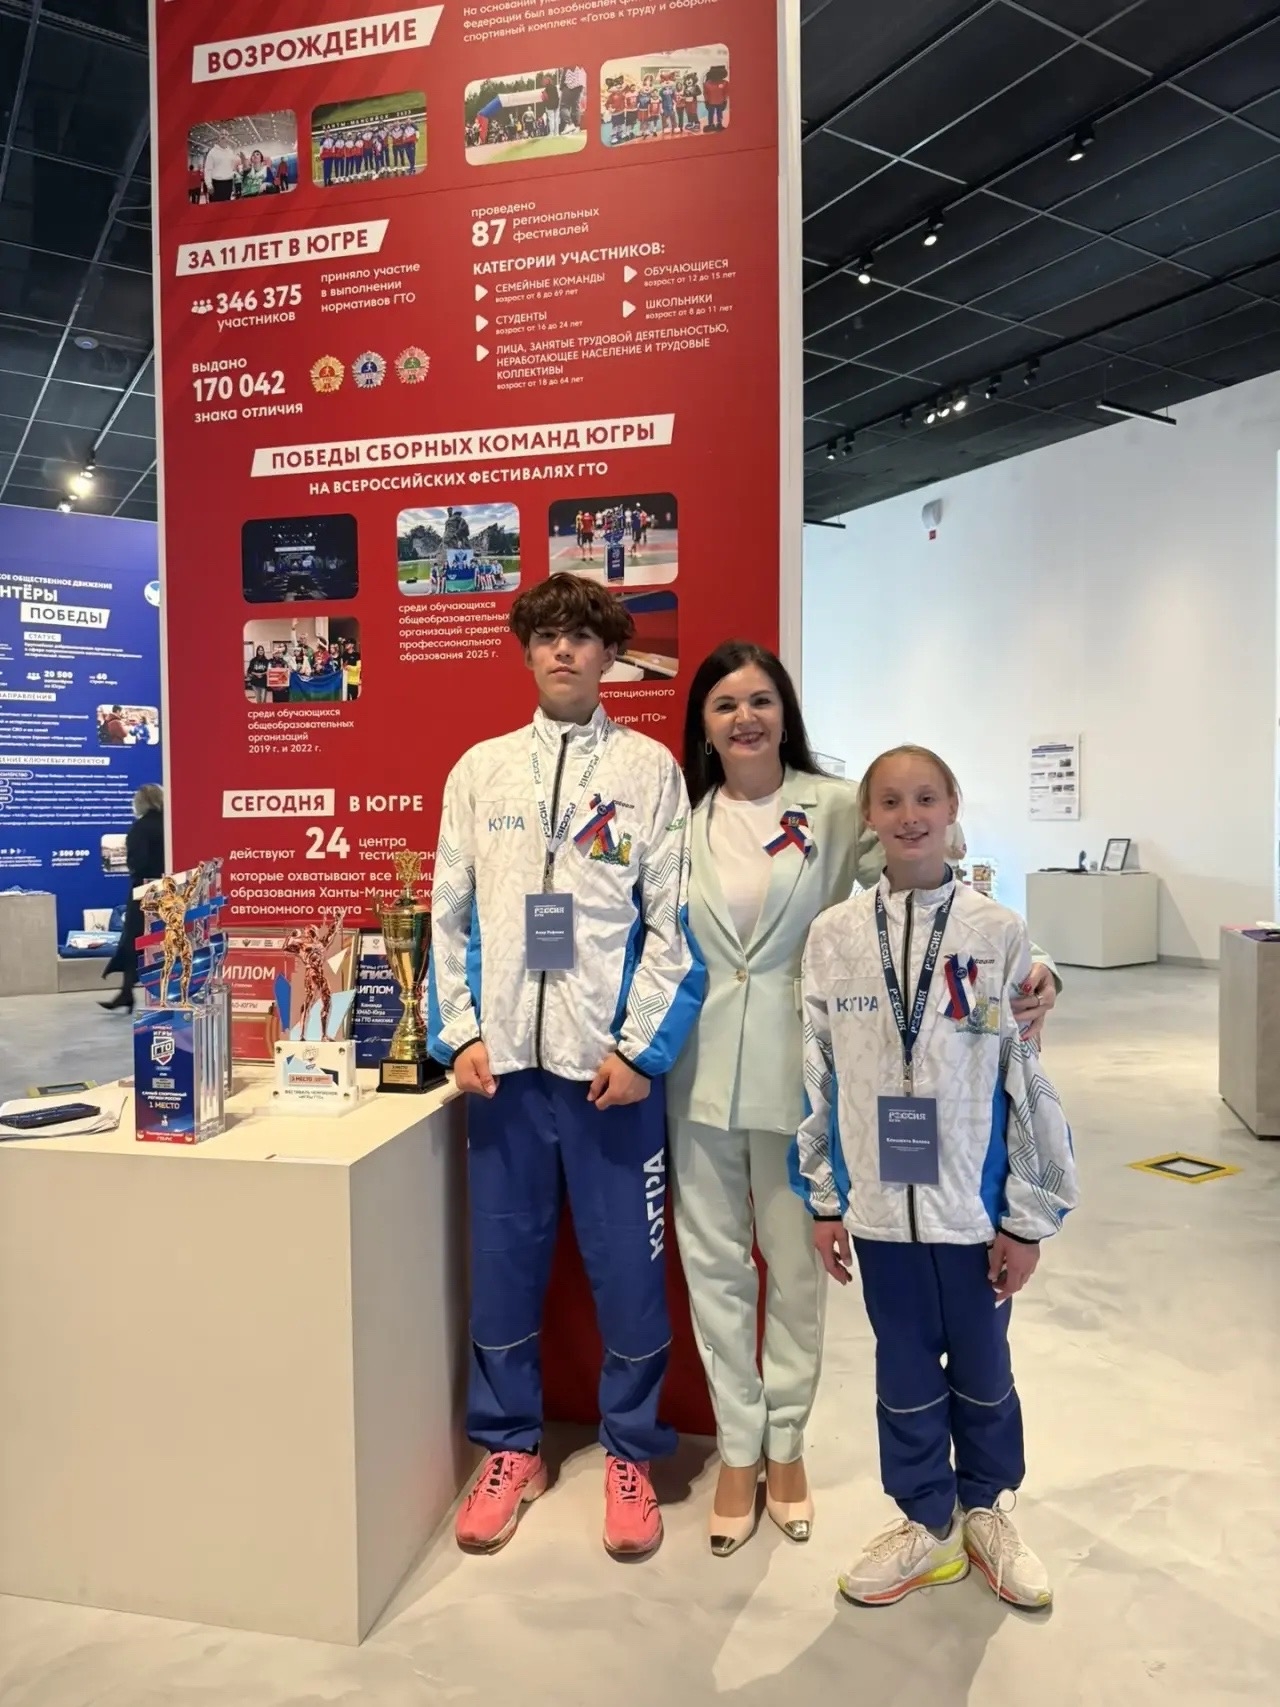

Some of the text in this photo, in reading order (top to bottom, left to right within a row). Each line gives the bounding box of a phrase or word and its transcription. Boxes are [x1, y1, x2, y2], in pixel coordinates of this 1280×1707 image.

[463, 7, 477, 16] На
[463, 9, 545, 29] Федерации был
[463, 24, 525, 42] спортивный
[528, 17, 577, 32] комплекс
[581, 11, 615, 22] «Готов
[627, 5, 656, 17] труду
[659, 3, 666, 11] и
[208, 19, 417, 73] ВОЗРОЖДЕНИЕ
[471, 202, 536, 219] проведено
[513, 208, 600, 228] региональных
[471, 218, 507, 247] 87
[513, 222, 589, 243] фестивалей
[188, 229, 368, 269] ЗА 11 ЛЕТ В ЮГРЕ
[473, 242, 665, 275] КАТЕГОРИИ УЧАСТНИКОВ:
[321, 263, 420, 284] приняло участие
[644, 259, 729, 277] ОБУЧАЮЩИЕСЯ
[321, 280, 402, 297] в выполнении
[495, 272, 605, 293] СЕМЕЙНЫЕ КОМАНДЫ
[644, 278, 675, 287] возраст
[216, 284, 302, 314] 346 375
[321, 292, 416, 314] нормативов ГТО
[495, 294, 525, 303] возраст
[554, 289, 563, 297] 69
[565, 288, 578, 296] лет
[645, 293, 713, 310] ШКОЛЬНИКИ
[217, 311, 296, 333] участников
[495, 311, 547, 325] СТУДЕНТЫ
[645, 311, 676, 320] возраст
[495, 327, 525, 335] возраст
[538, 323, 546, 331] 16
[570, 320, 583, 328] лет
[496, 323, 729, 355] ЛИЦА, ЗАНЯТЫЕ ТРУДОВОЙ ДЕЯТЕЛЬНОСТЬЮ,
[496, 338, 710, 367] НЕРАБОТАЮЩЕЕ НАСЕЛЕНИЕ И ТРУДОВЫЕ
[192, 358, 247, 373] выдано
[496, 365, 564, 380] КОЛЛЕКТИВЫ
[192, 370, 285, 402] 170 042
[497, 381, 526, 390] возраст
[194, 403, 303, 423] знака отличия
[272, 422, 654, 469] ПОБЕДЫ СБОРНЫХ КОМАНД ЮГРЫ
[309, 462, 608, 495] НА ВСЕРОССИЙСКИХ ФЕСТИВАЛЯХ ГТО
[12, 574, 113, 590] ОБЩЕСТВЕННОЕ ДВИЖЕНИЕ
[0, 584, 58, 602] НТЁРЫ
[30, 607, 102, 624] ПОБЕДЫ
[398, 601, 496, 614] среди обучающихся
[399, 613, 511, 625] общеобразовательных
[399, 626, 511, 638] организаций среднего
[399, 638, 502, 651] профессионального
[399, 650, 499, 663] образования 2025 г.
[599, 689, 675, 699] истанционного
[247, 709, 341, 720] среди обучающихся
[614, 713, 667, 724] игры ГТО»
[247, 720, 354, 731] общеобразовательных
[248, 732, 308, 743] организаций
[248, 745, 271, 754] 2019
[290, 744, 313, 753] 2022
[231, 795, 423, 814] СЕГОДНЯ В ЮГРЕ
[305, 826, 350, 859] 24
[358, 836, 406, 849] центра
[229, 847, 295, 861] действуют
[230, 871, 284, 884] которые
[287, 871, 365, 882] охватывают
[369, 871, 392, 881] все
[230, 886, 316, 899] образования
[231, 904, 361, 917] автономного округа
[359, 985, 394, 995] ИПЛОМ
[155, 1043, 172, 1055] ГТО
